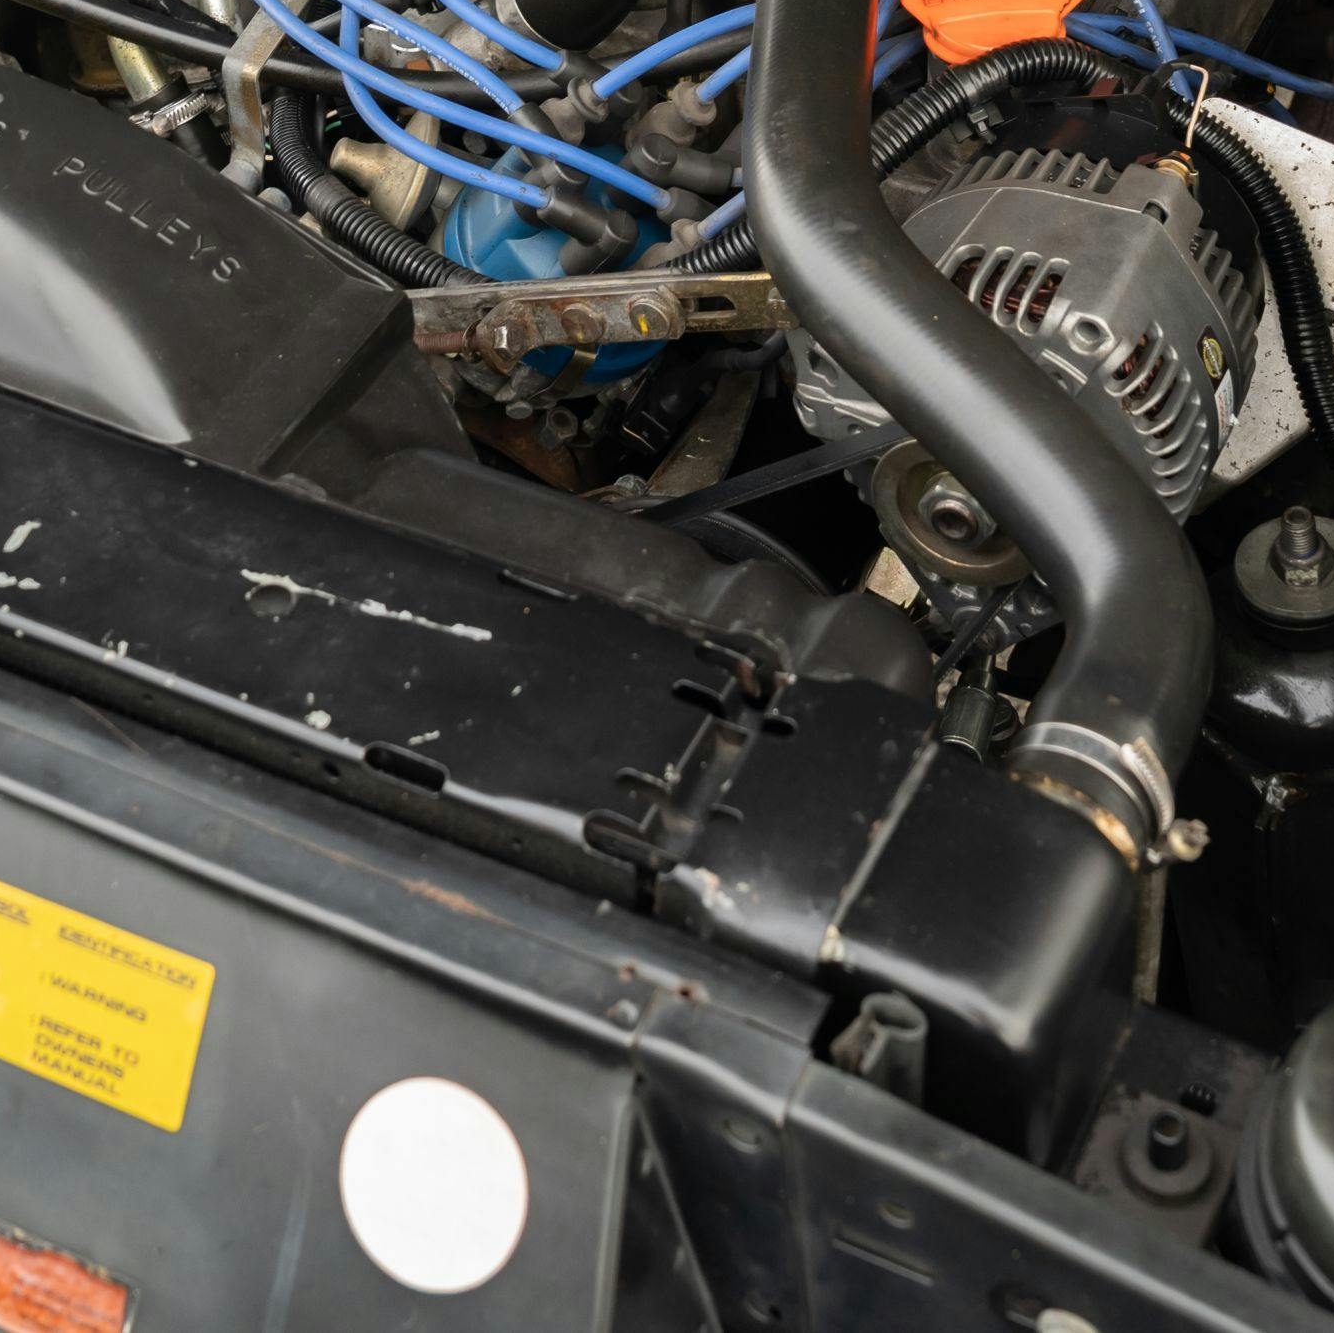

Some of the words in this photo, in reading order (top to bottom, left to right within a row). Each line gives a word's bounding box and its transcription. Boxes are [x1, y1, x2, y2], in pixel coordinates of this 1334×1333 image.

[52, 154, 242, 284] PULLEYS
[58, 924, 196, 990] IDENTIFICATION
[30, 1050, 120, 1095] MANUAL
[34, 1033, 125, 1078] OWNERS
[112, 1044, 141, 1067] TO
